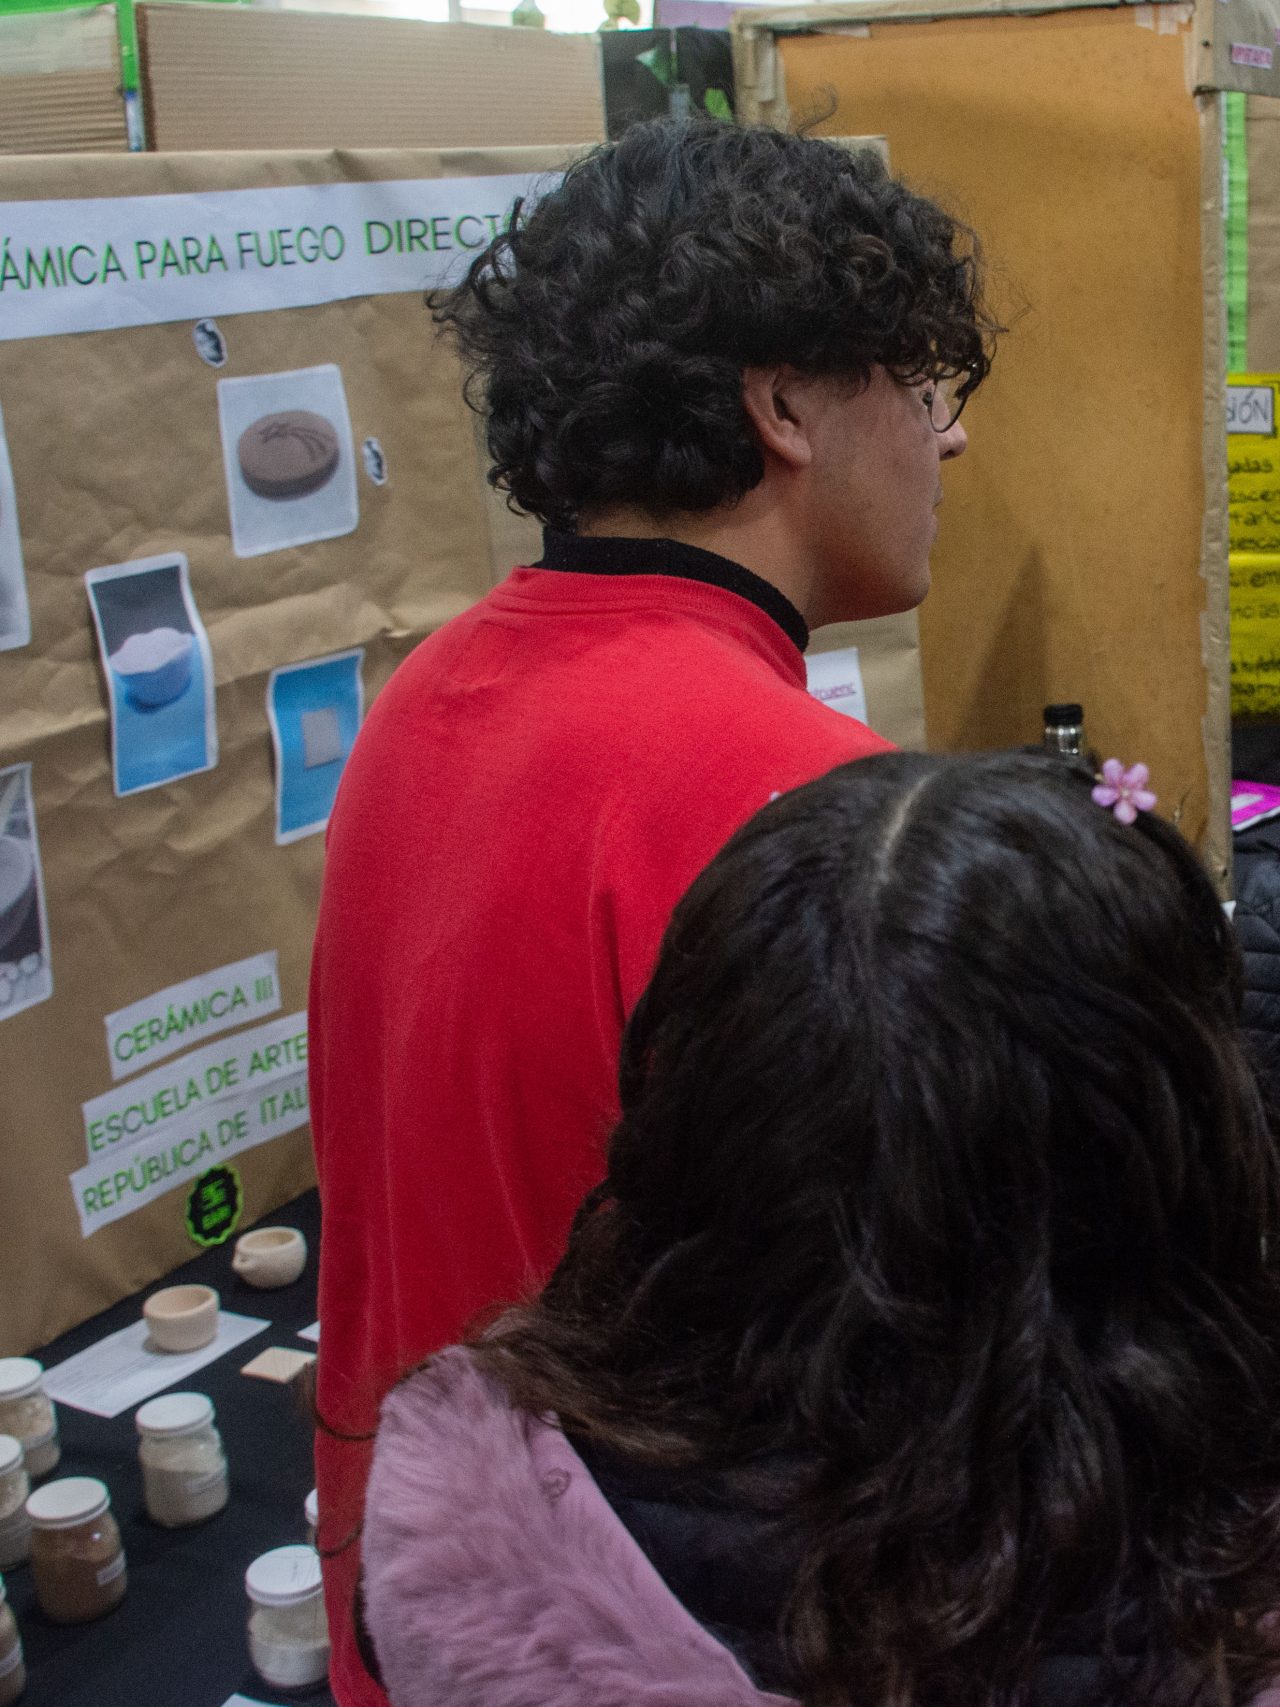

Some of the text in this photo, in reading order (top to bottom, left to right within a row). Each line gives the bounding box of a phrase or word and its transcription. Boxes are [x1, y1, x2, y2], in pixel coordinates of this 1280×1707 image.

[0, 237, 128, 291] ÁMICA
[135, 234, 228, 280] PARA
[236, 224, 345, 270] FUEGO
[113, 975, 275, 1062] CERÁMICA III
[87, 1078, 203, 1152] ESCUELA
[205, 1057, 240, 1095] DE
[82, 1130, 213, 1216] REPÚBLICA
[216, 1110, 249, 1148] DE
